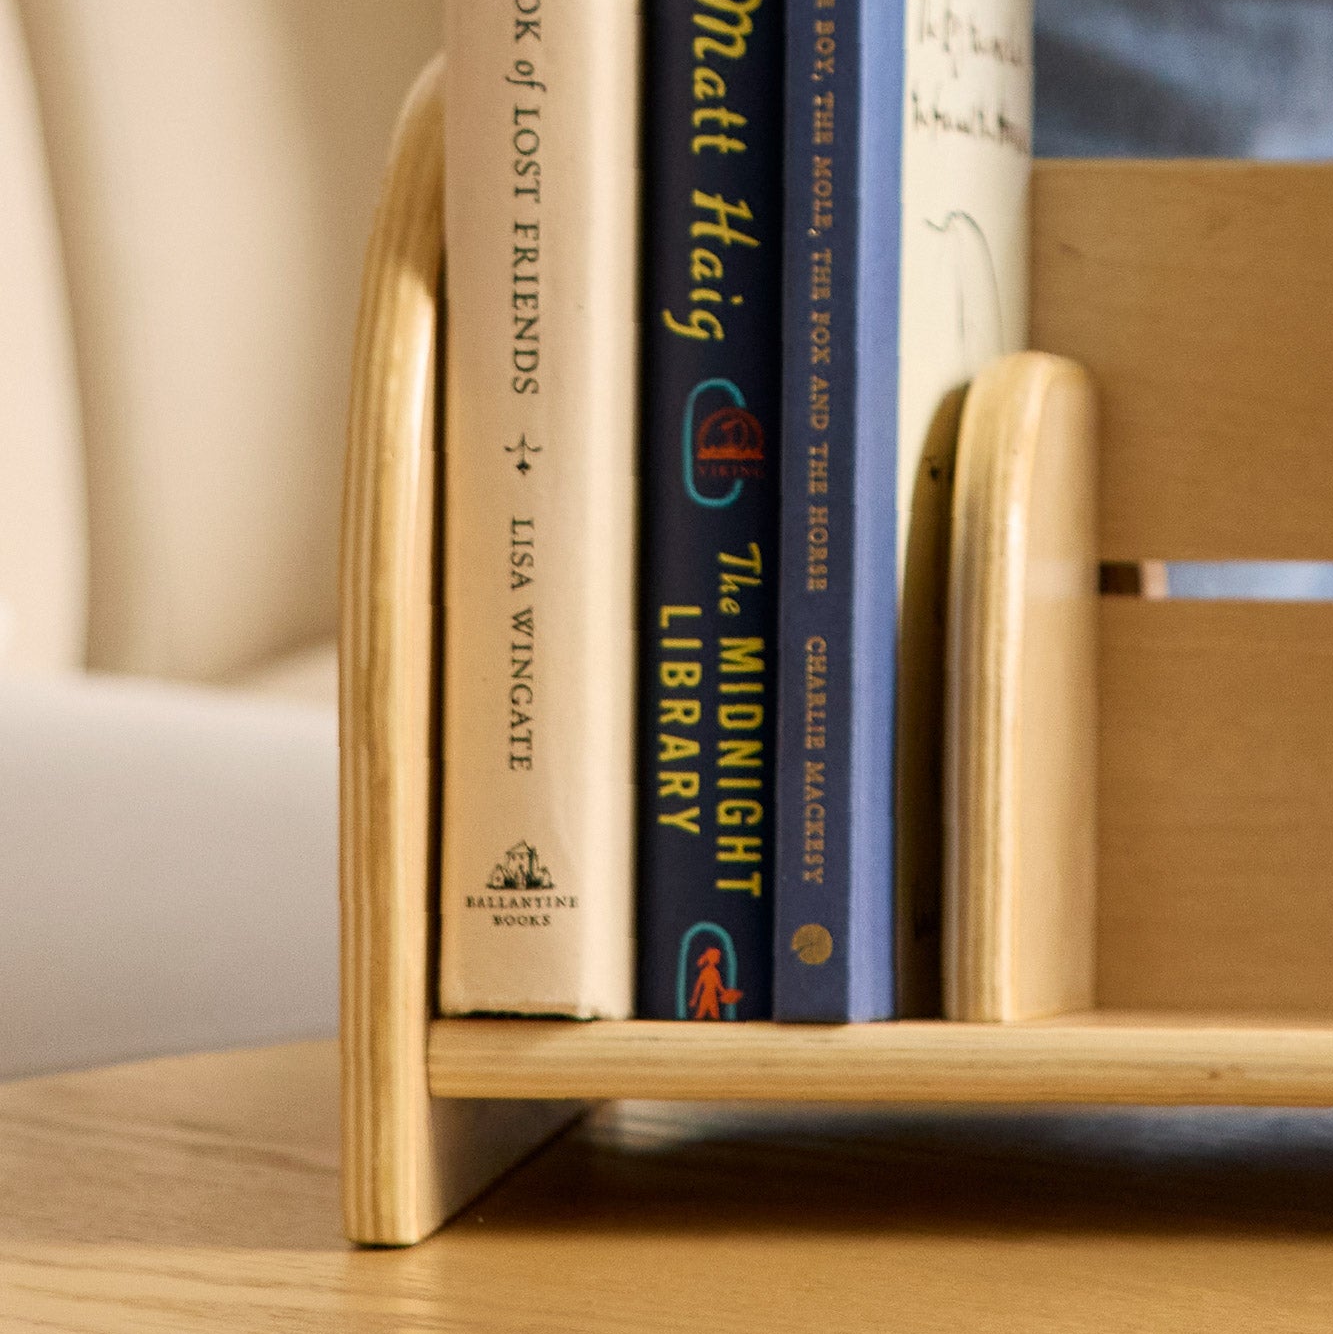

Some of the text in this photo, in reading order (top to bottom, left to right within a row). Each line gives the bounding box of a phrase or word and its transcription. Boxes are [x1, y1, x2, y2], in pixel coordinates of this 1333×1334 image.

[505, 60, 546, 92] of
[811, 20, 835, 81] BOY,
[512, 103, 540, 203] LOST
[812, 91, 834, 145] THE
[808, 155, 832, 239] MOLE,
[663, 189, 760, 341] Haig
[811, 248, 833, 300] THE
[512, 220, 540, 395] FRIENDS
[810, 312, 831, 364] FOX
[810, 374, 830, 430] AND
[808, 442, 828, 494] THE
[807, 506, 828, 591] HORSE
[509, 515, 534, 771] LISA WINGATE
[658, 605, 702, 834] LIBRARY
[716, 543, 765, 897] The MIDNIGHT
[803, 635, 827, 884] CHARLIE MACKESY
[465, 895, 579, 927] BALLANTINE BOOKS
